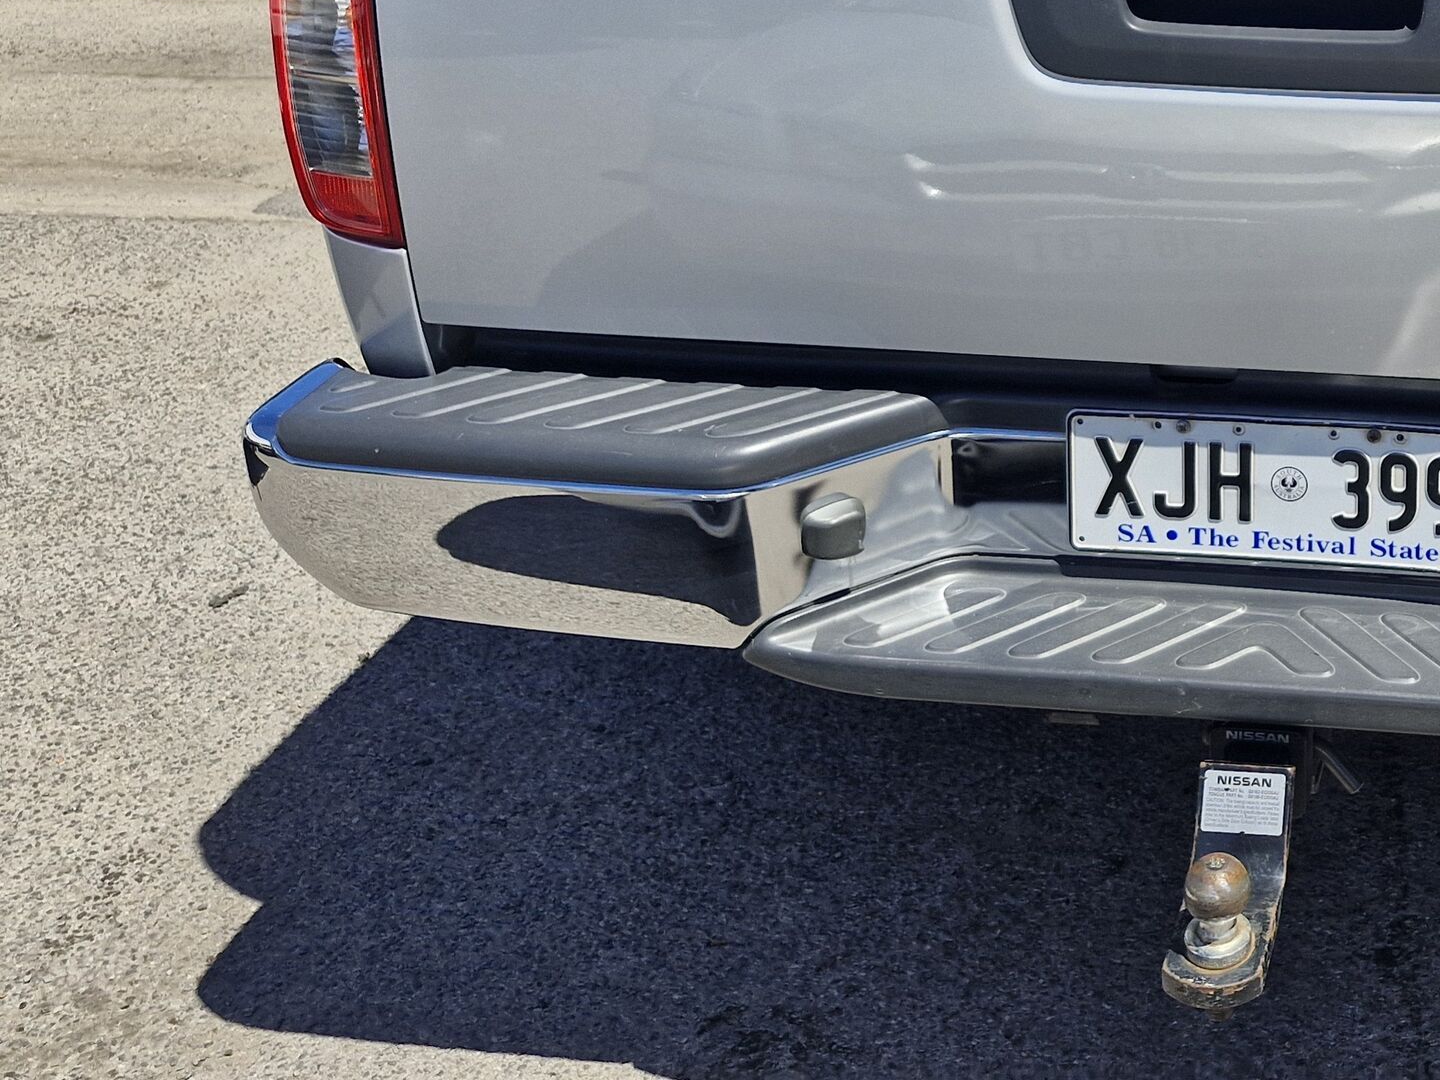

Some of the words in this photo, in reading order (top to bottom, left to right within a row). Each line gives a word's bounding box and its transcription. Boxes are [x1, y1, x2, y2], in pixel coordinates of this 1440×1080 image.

[1094, 435, 1255, 523] XJH
[1117, 523, 1157, 544] SA
[1188, 527, 1239, 548] The
[1252, 530, 1357, 555] Festival
[1370, 538, 1440, 562] State
[1225, 729, 1290, 744] NISSAN
[1217, 775, 1272, 787] NISSAN
